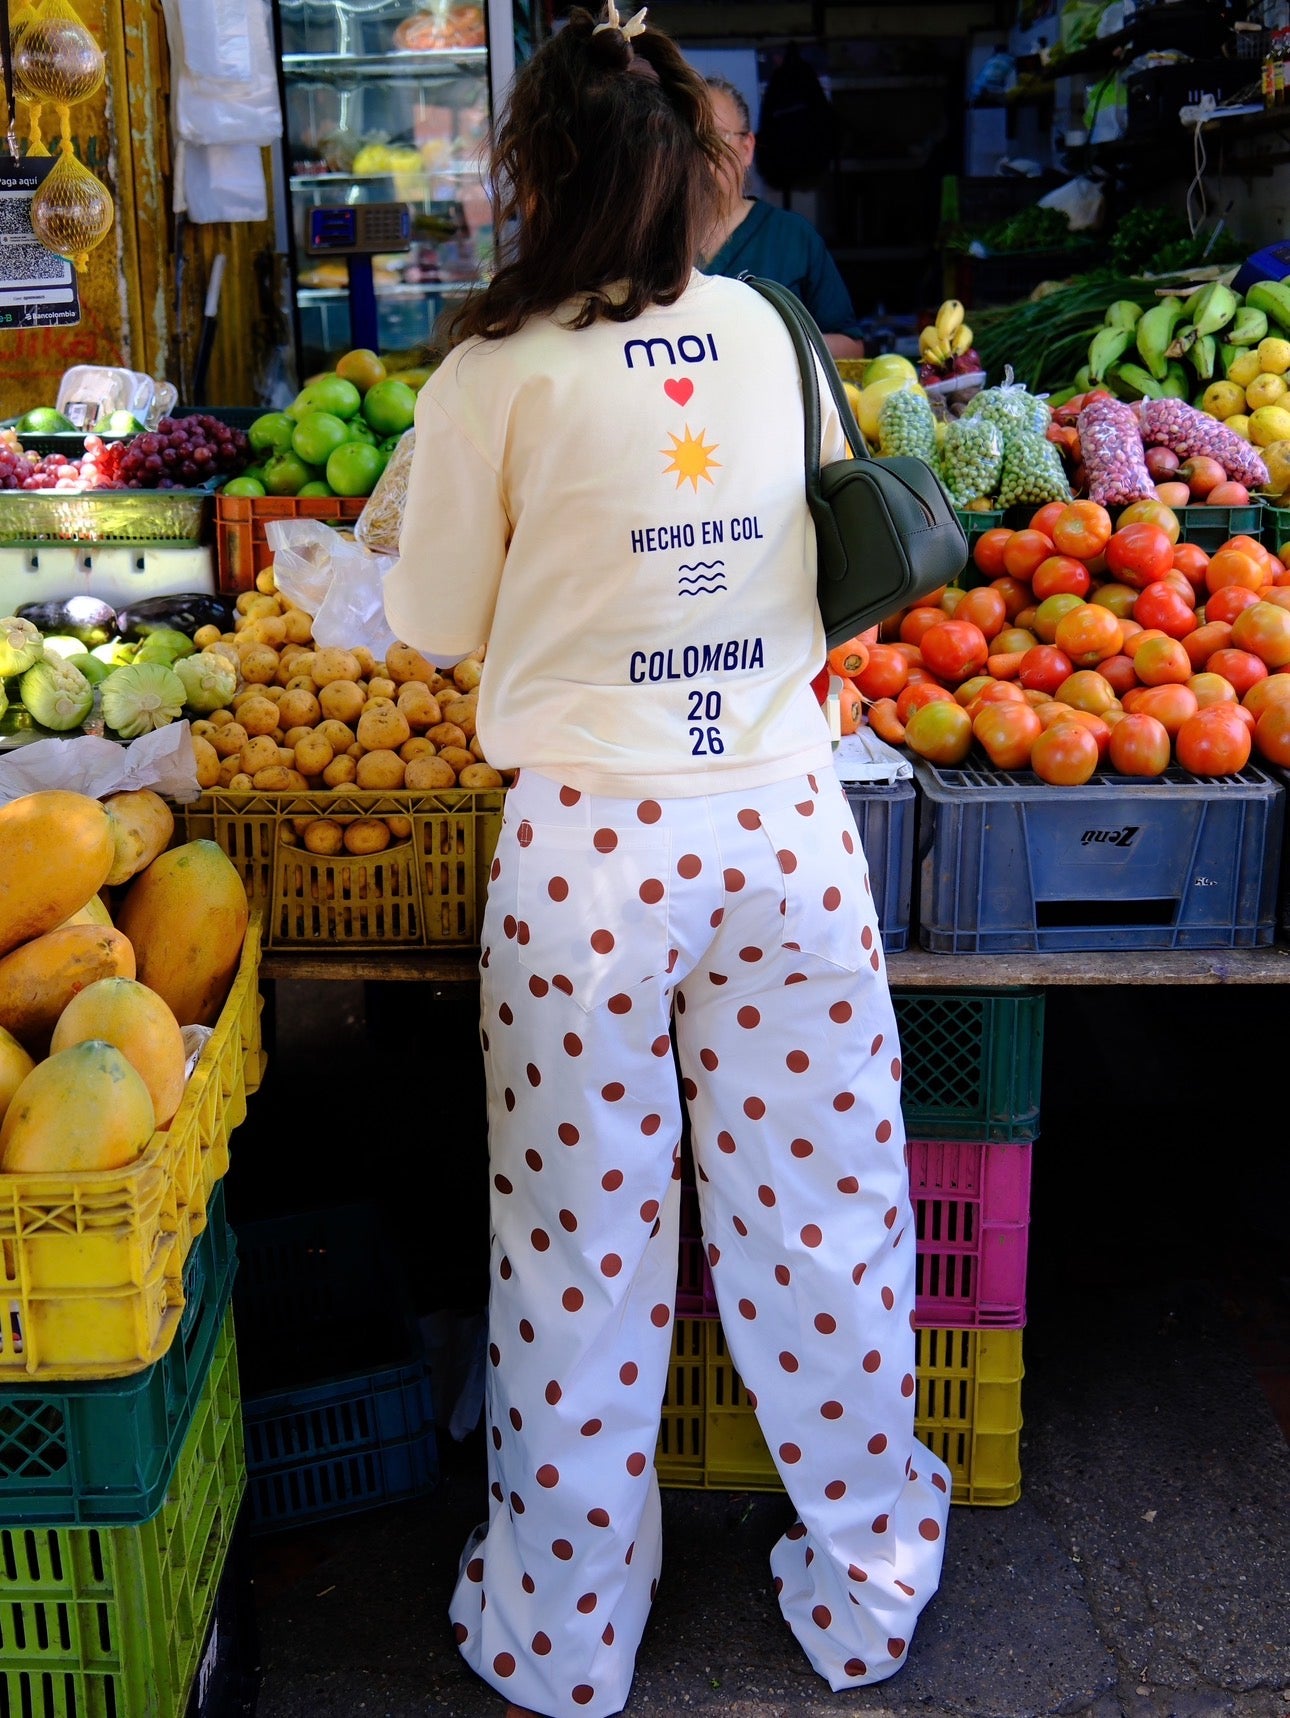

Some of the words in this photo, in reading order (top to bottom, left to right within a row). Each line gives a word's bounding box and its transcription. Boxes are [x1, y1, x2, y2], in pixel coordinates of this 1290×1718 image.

[33, 310, 76, 319] Bancolombia
[631, 523, 695, 553] HECHO
[701, 519, 724, 545] EN
[730, 516, 764, 542] COL
[629, 637, 764, 683] COLOMBIA
[687, 690, 722, 721] 20
[689, 726, 725, 756] 26
[1080, 826, 1140, 848] Zenú
